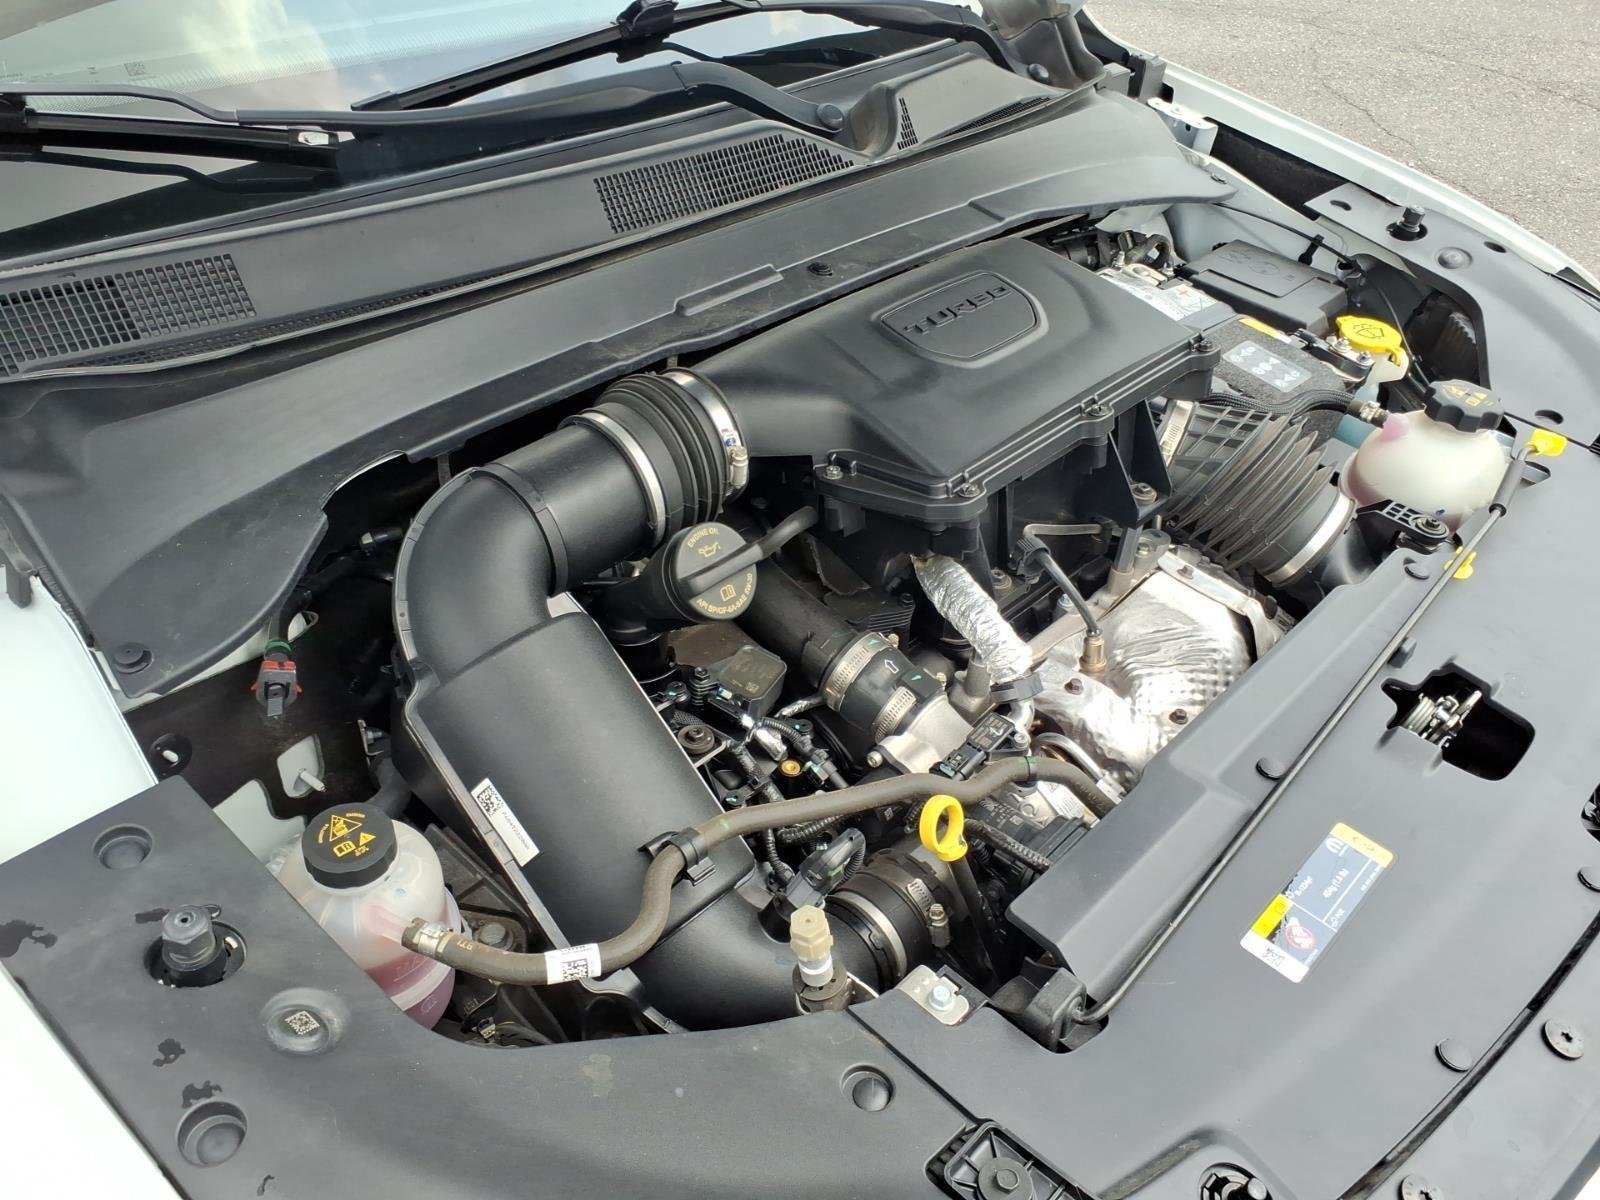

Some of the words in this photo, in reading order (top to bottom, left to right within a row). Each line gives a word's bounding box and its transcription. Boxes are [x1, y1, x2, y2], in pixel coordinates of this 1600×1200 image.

[903, 286, 1012, 334] TURBO
[688, 528, 709, 548] ENGINE
[709, 527, 719, 535] OIL
